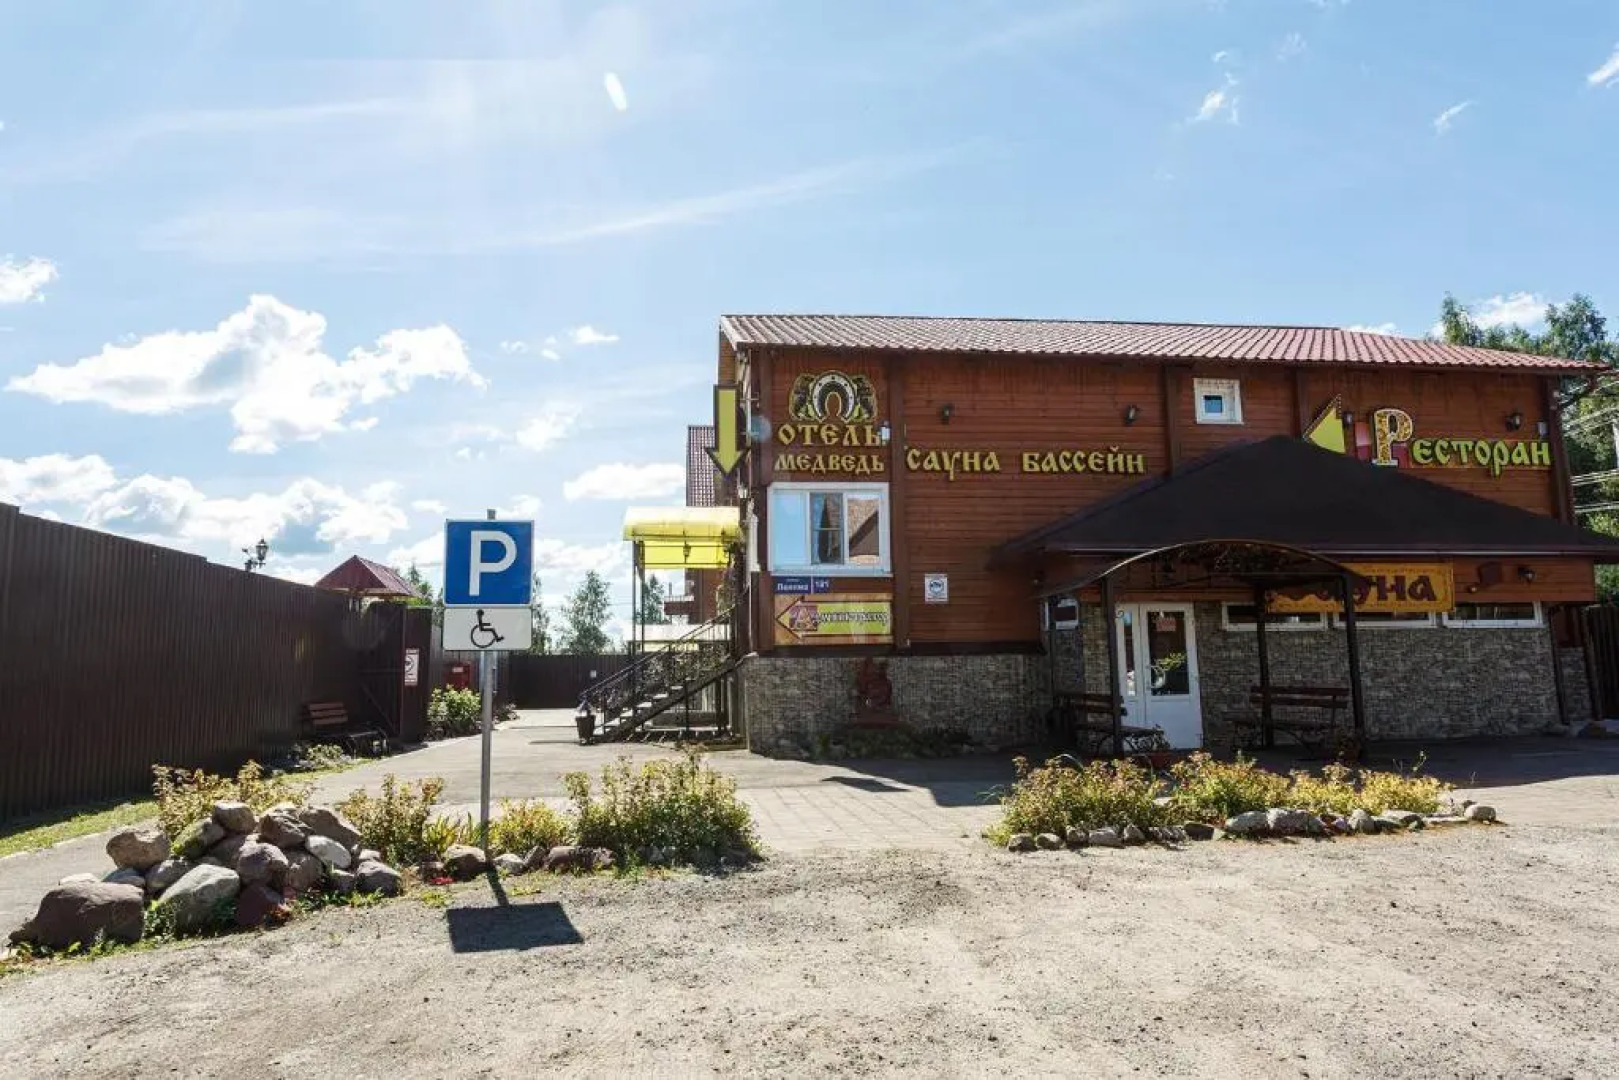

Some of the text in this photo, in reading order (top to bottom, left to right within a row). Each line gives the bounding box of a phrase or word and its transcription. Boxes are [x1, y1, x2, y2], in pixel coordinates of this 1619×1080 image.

[778, 423, 880, 446] ОТЕЛЬ
[774, 453, 885, 475] МЕДВЕДЬ
[469, 530, 517, 596] P
